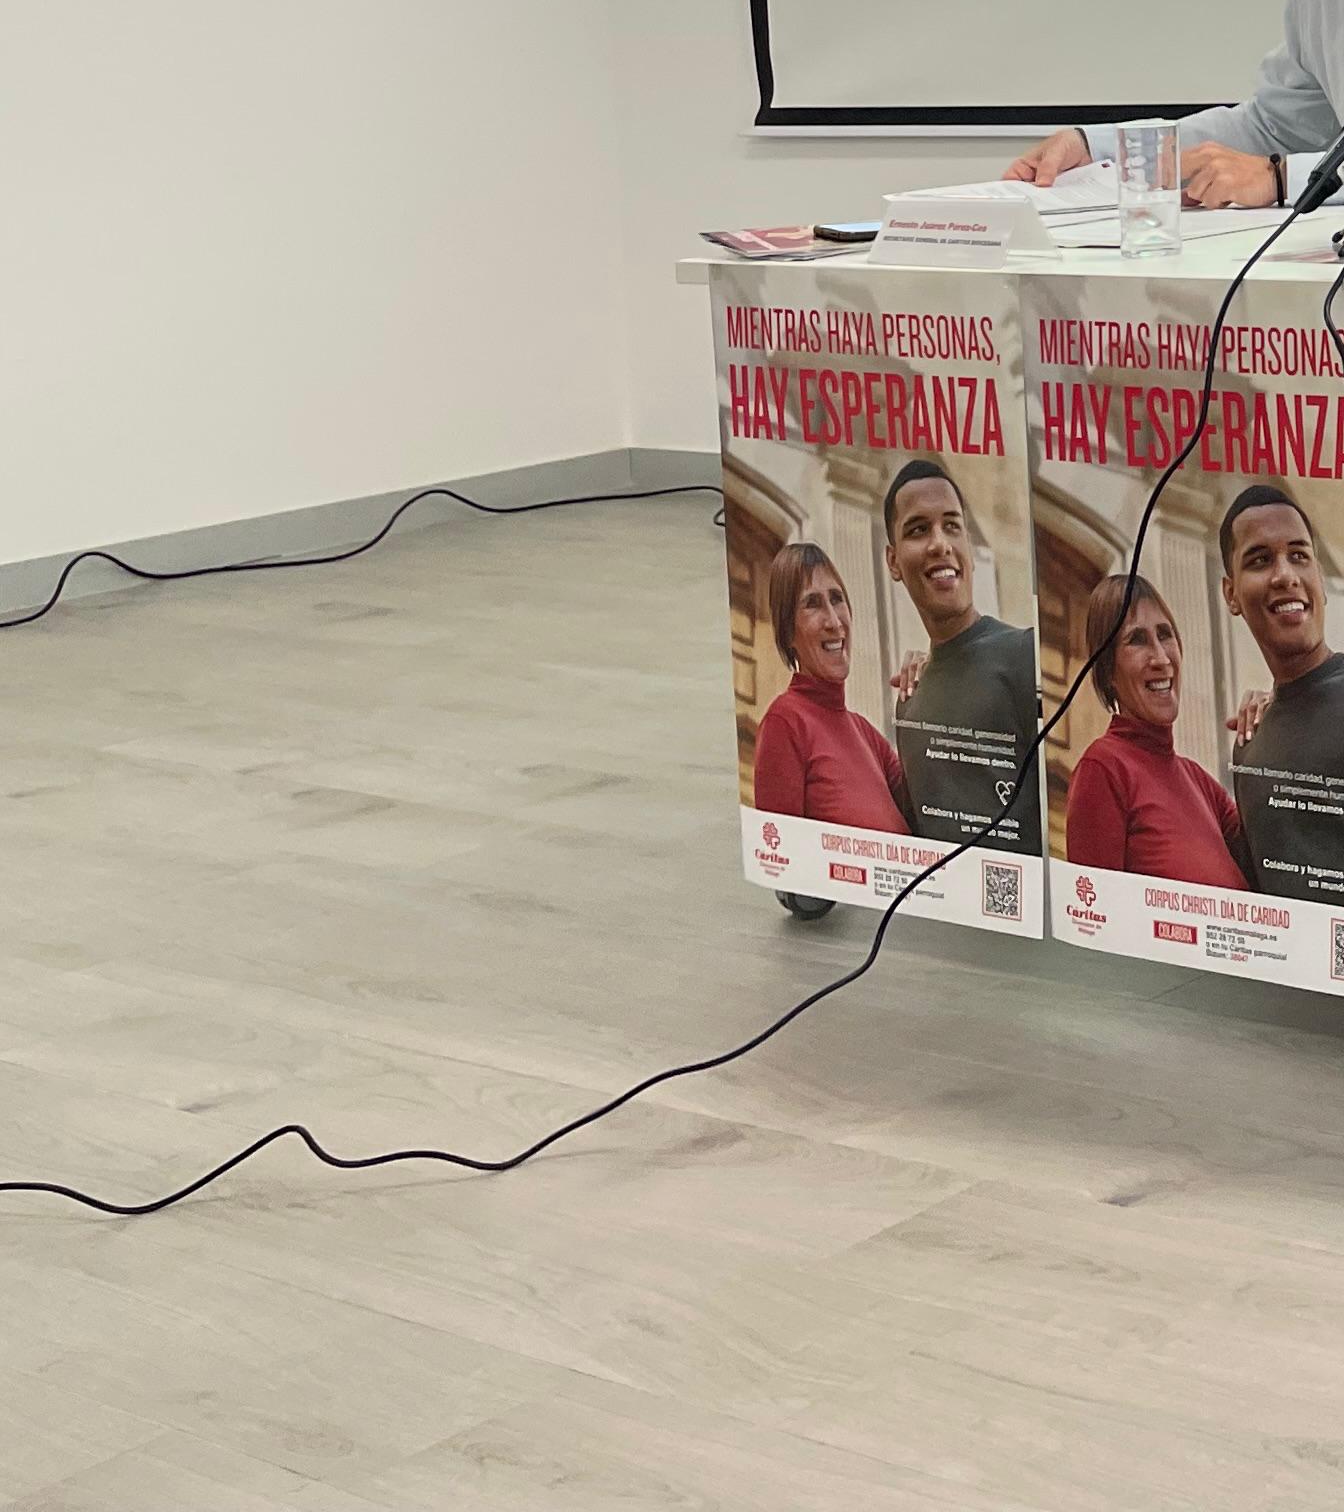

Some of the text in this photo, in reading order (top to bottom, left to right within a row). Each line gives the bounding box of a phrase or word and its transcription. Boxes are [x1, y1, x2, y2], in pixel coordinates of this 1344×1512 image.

[726, 305, 1001, 366] MIENTRAS HAYA PERSONAS,
[1039, 318, 1151, 370] MIENTRAS
[1158, 323, 1214, 373] HAYA
[729, 364, 1005, 457] HAY ESPERANZA
[1042, 381, 1112, 465] HAY
[1145, 888, 1290, 929] CORPUS CHRISTI. DÍA DE CARIDAD
